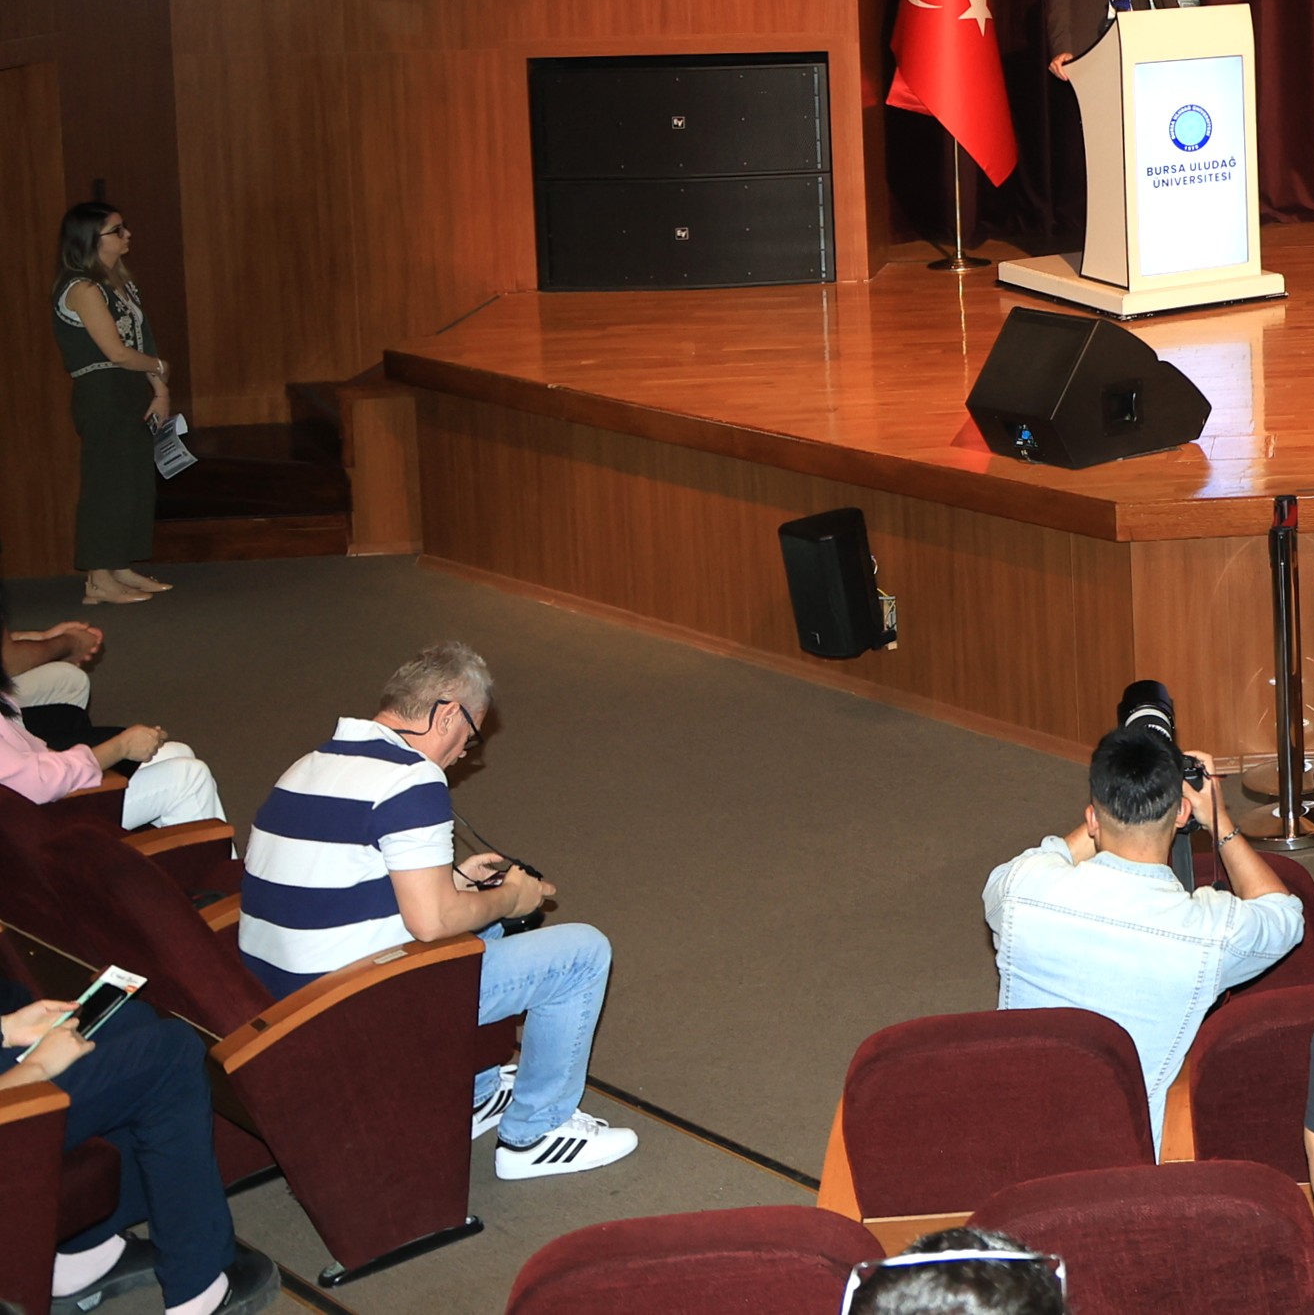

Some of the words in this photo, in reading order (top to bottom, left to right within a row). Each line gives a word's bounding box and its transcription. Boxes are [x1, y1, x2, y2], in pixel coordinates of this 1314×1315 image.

[1146, 164, 1186, 177] BURSA
[1189, 156, 1237, 172] ULUDAĞ
[1152, 171, 1232, 189] ÜNİVERSİTESİ
